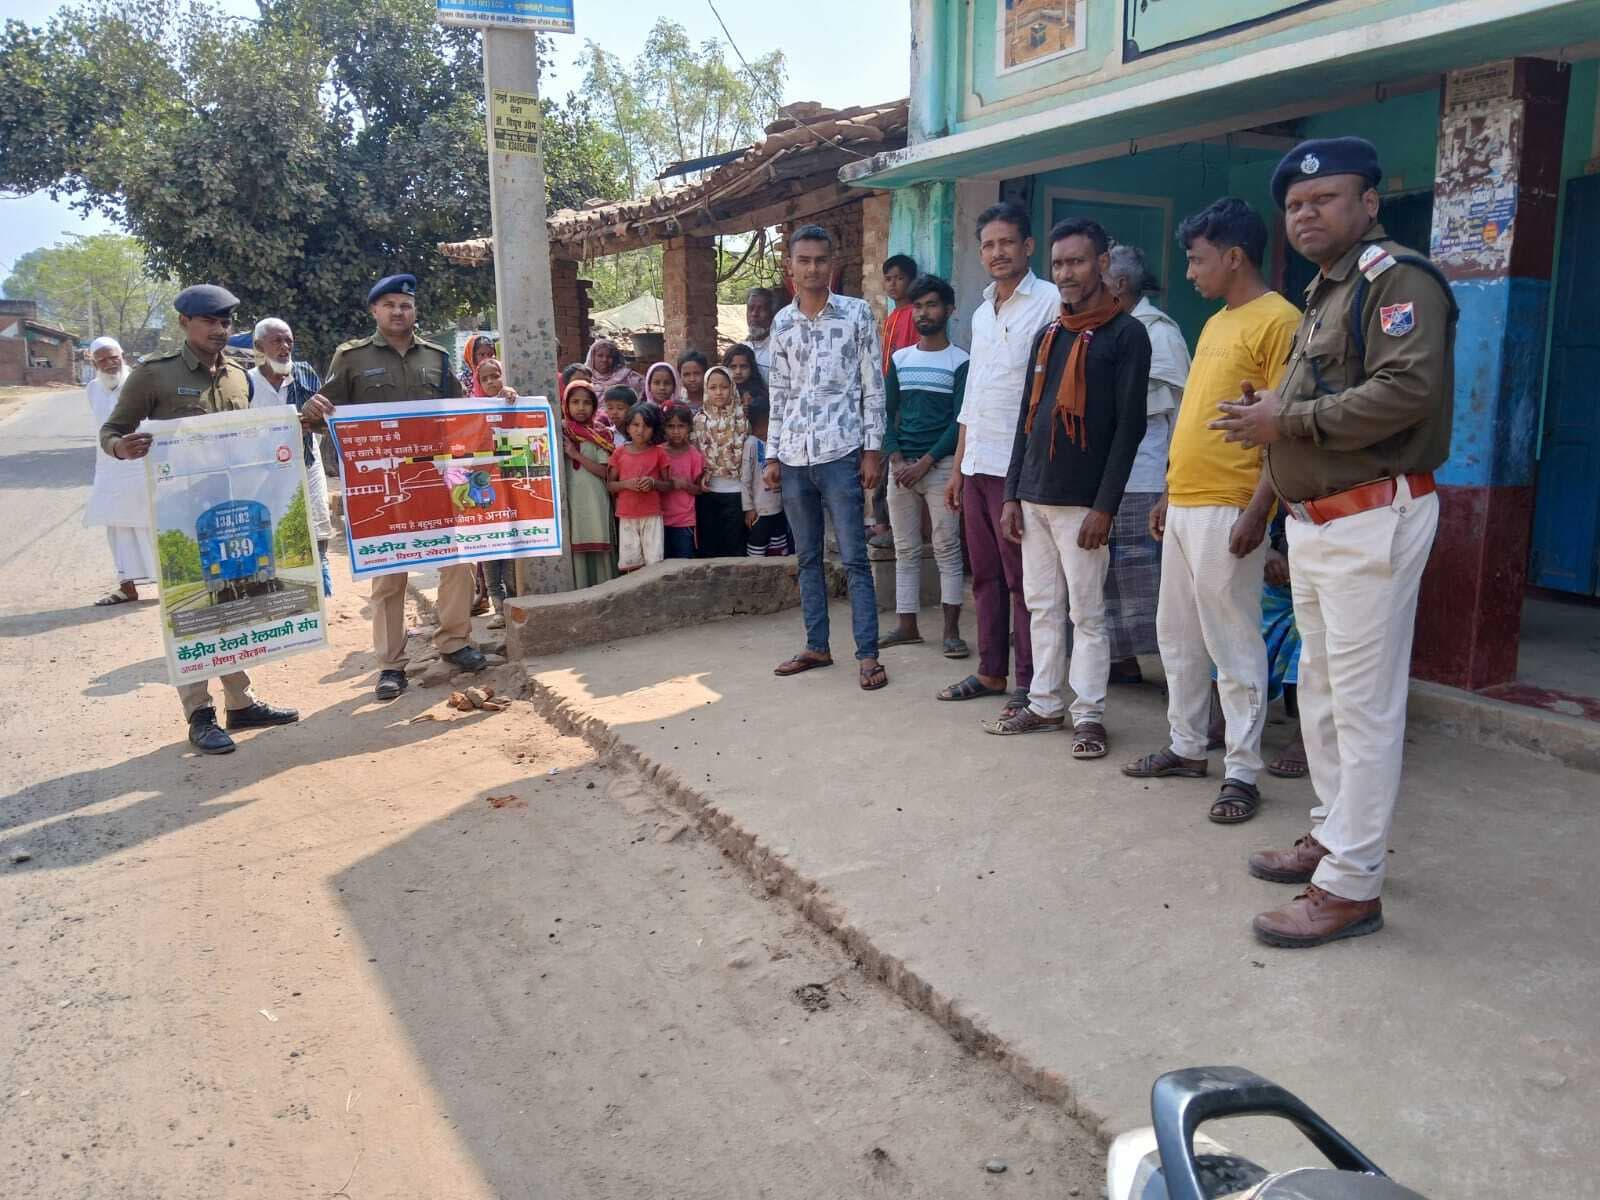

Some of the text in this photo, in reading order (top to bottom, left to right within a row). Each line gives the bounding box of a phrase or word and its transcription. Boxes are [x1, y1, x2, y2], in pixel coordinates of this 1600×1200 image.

[218, 537, 254, 561] 139
[358, 540, 406, 557] केंद्रीय
[412, 534, 451, 549] रेलवे
[456, 532, 482, 544] रेल
[486, 527, 519, 540] यात्री
[522, 526, 551, 538] संघ
[177, 642, 216, 661] केंद्रीय
[219, 632, 249, 651] रेलवे
[251, 620, 294, 643] रेलयात्री
[297, 618, 318, 633] संघ
